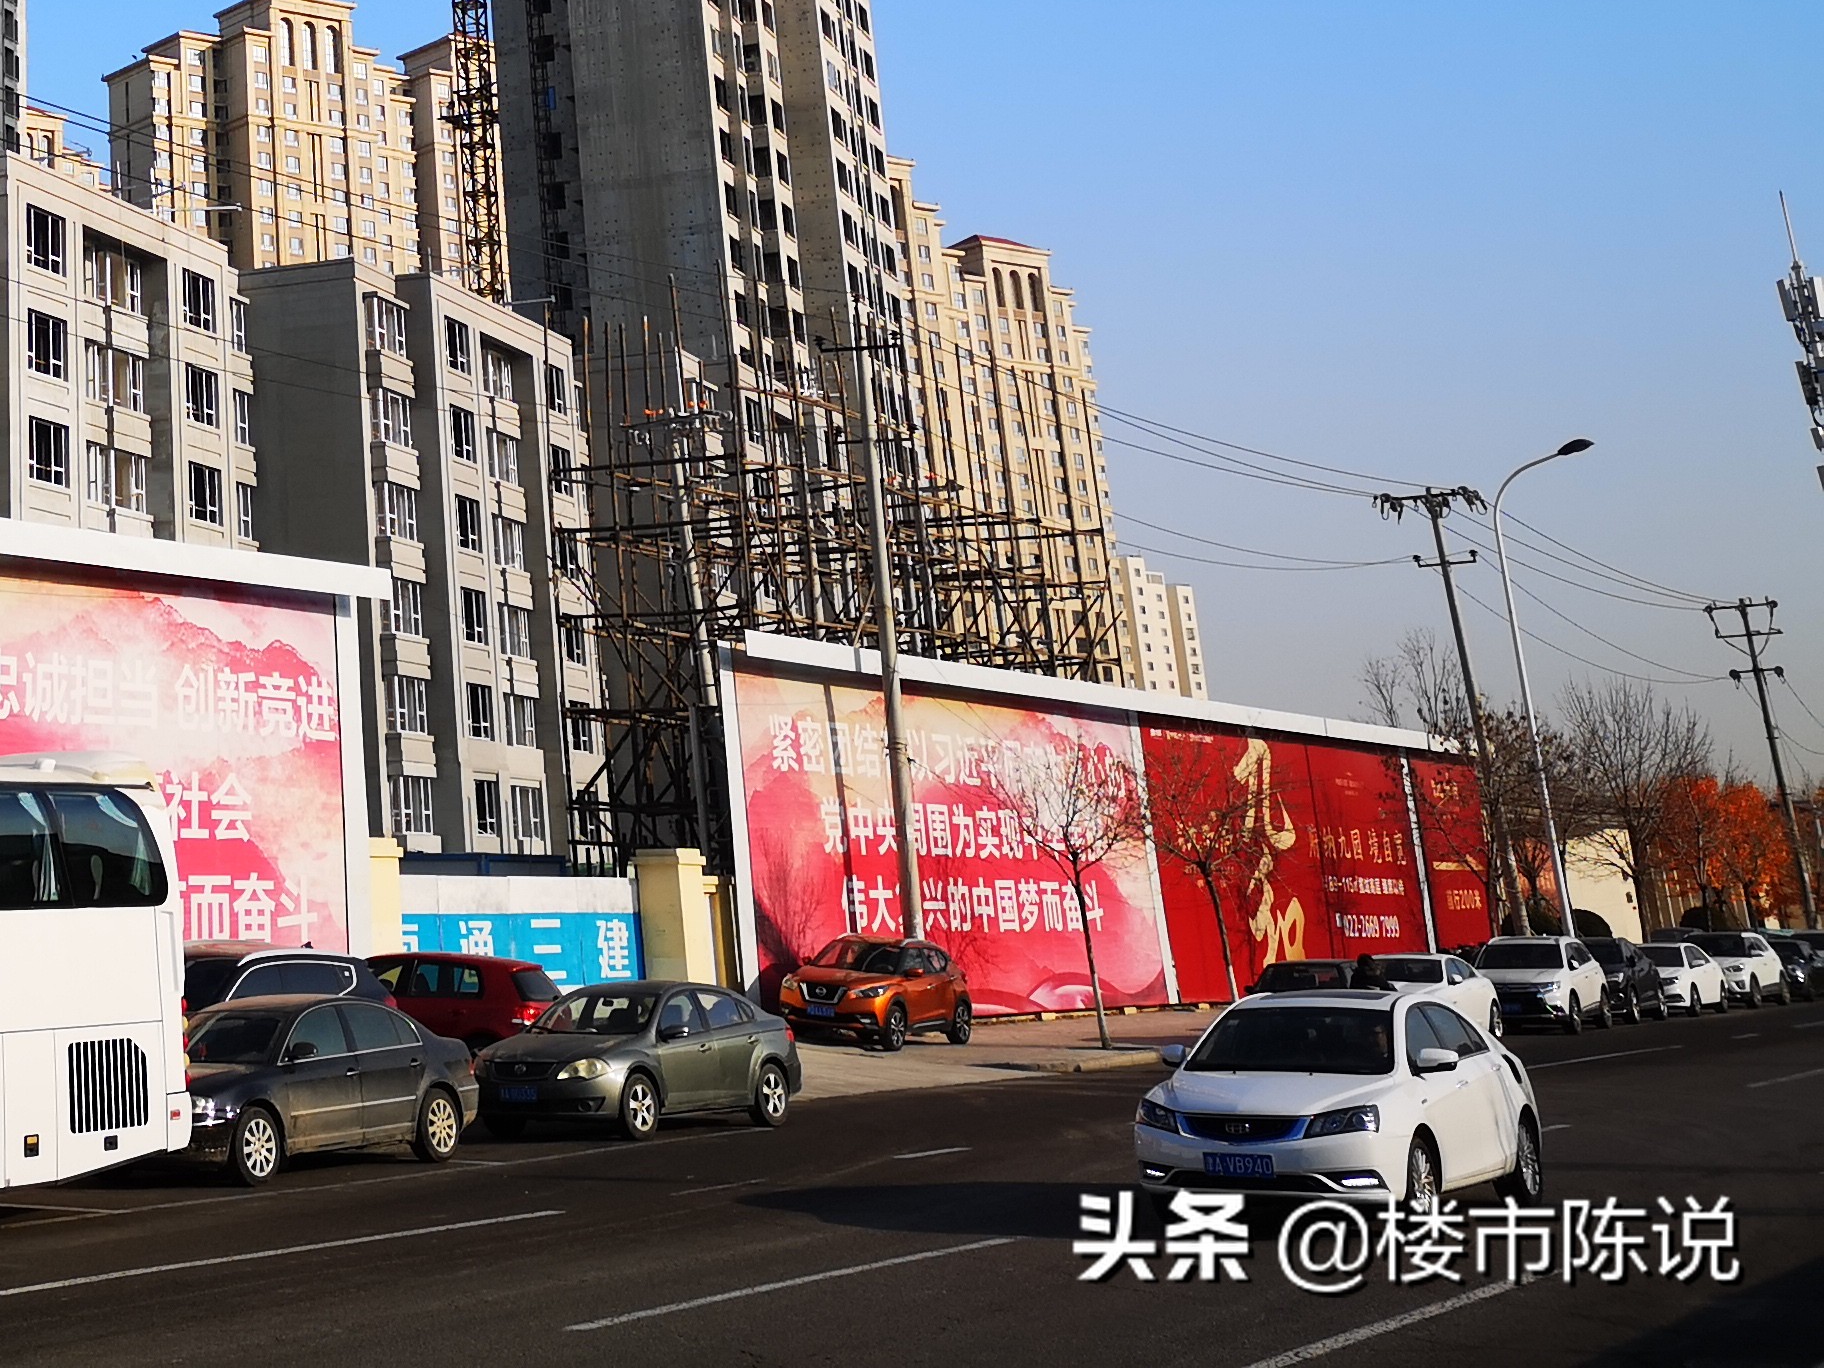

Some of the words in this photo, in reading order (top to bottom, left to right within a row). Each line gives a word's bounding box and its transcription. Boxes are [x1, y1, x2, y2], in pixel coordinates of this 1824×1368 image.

[175, 663, 337, 742] 创新竞进
[156, 770, 252, 843] 社会
[178, 872, 318, 943] 而奋斗
[842, 875, 1104, 933] 伟大兴的中国梦而奋斗
[402, 918, 631, 979] 通三建
